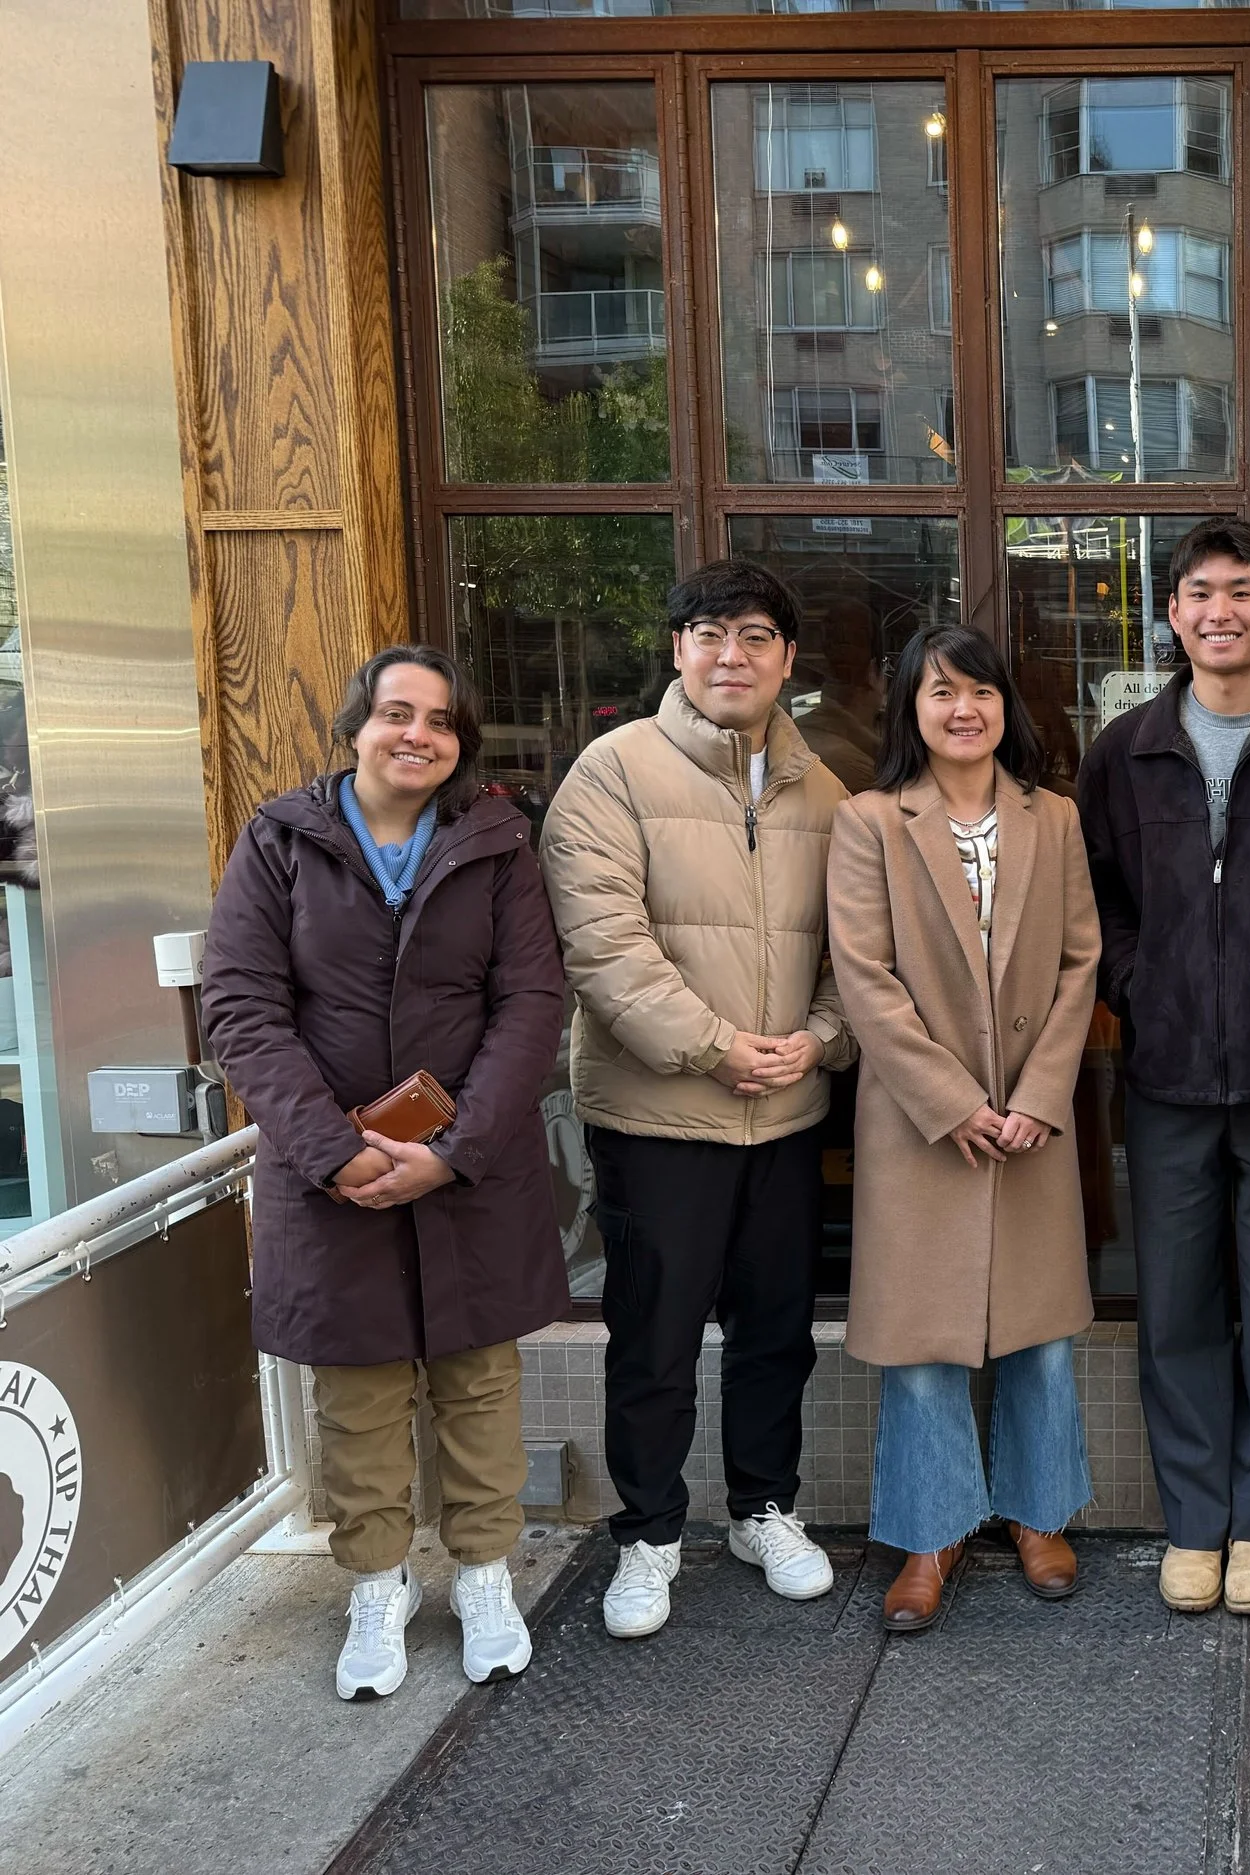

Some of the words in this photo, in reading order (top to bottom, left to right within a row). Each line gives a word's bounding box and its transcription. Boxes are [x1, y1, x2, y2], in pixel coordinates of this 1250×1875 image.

[1124, 683, 1141, 693] All
[1114, 699, 1138, 709] driv
[114, 1083, 150, 1097] DEP
[0, 1368, 37, 1409] AI
[55, 1447, 78, 1503] UP
[13, 1520, 73, 1628] THAI
